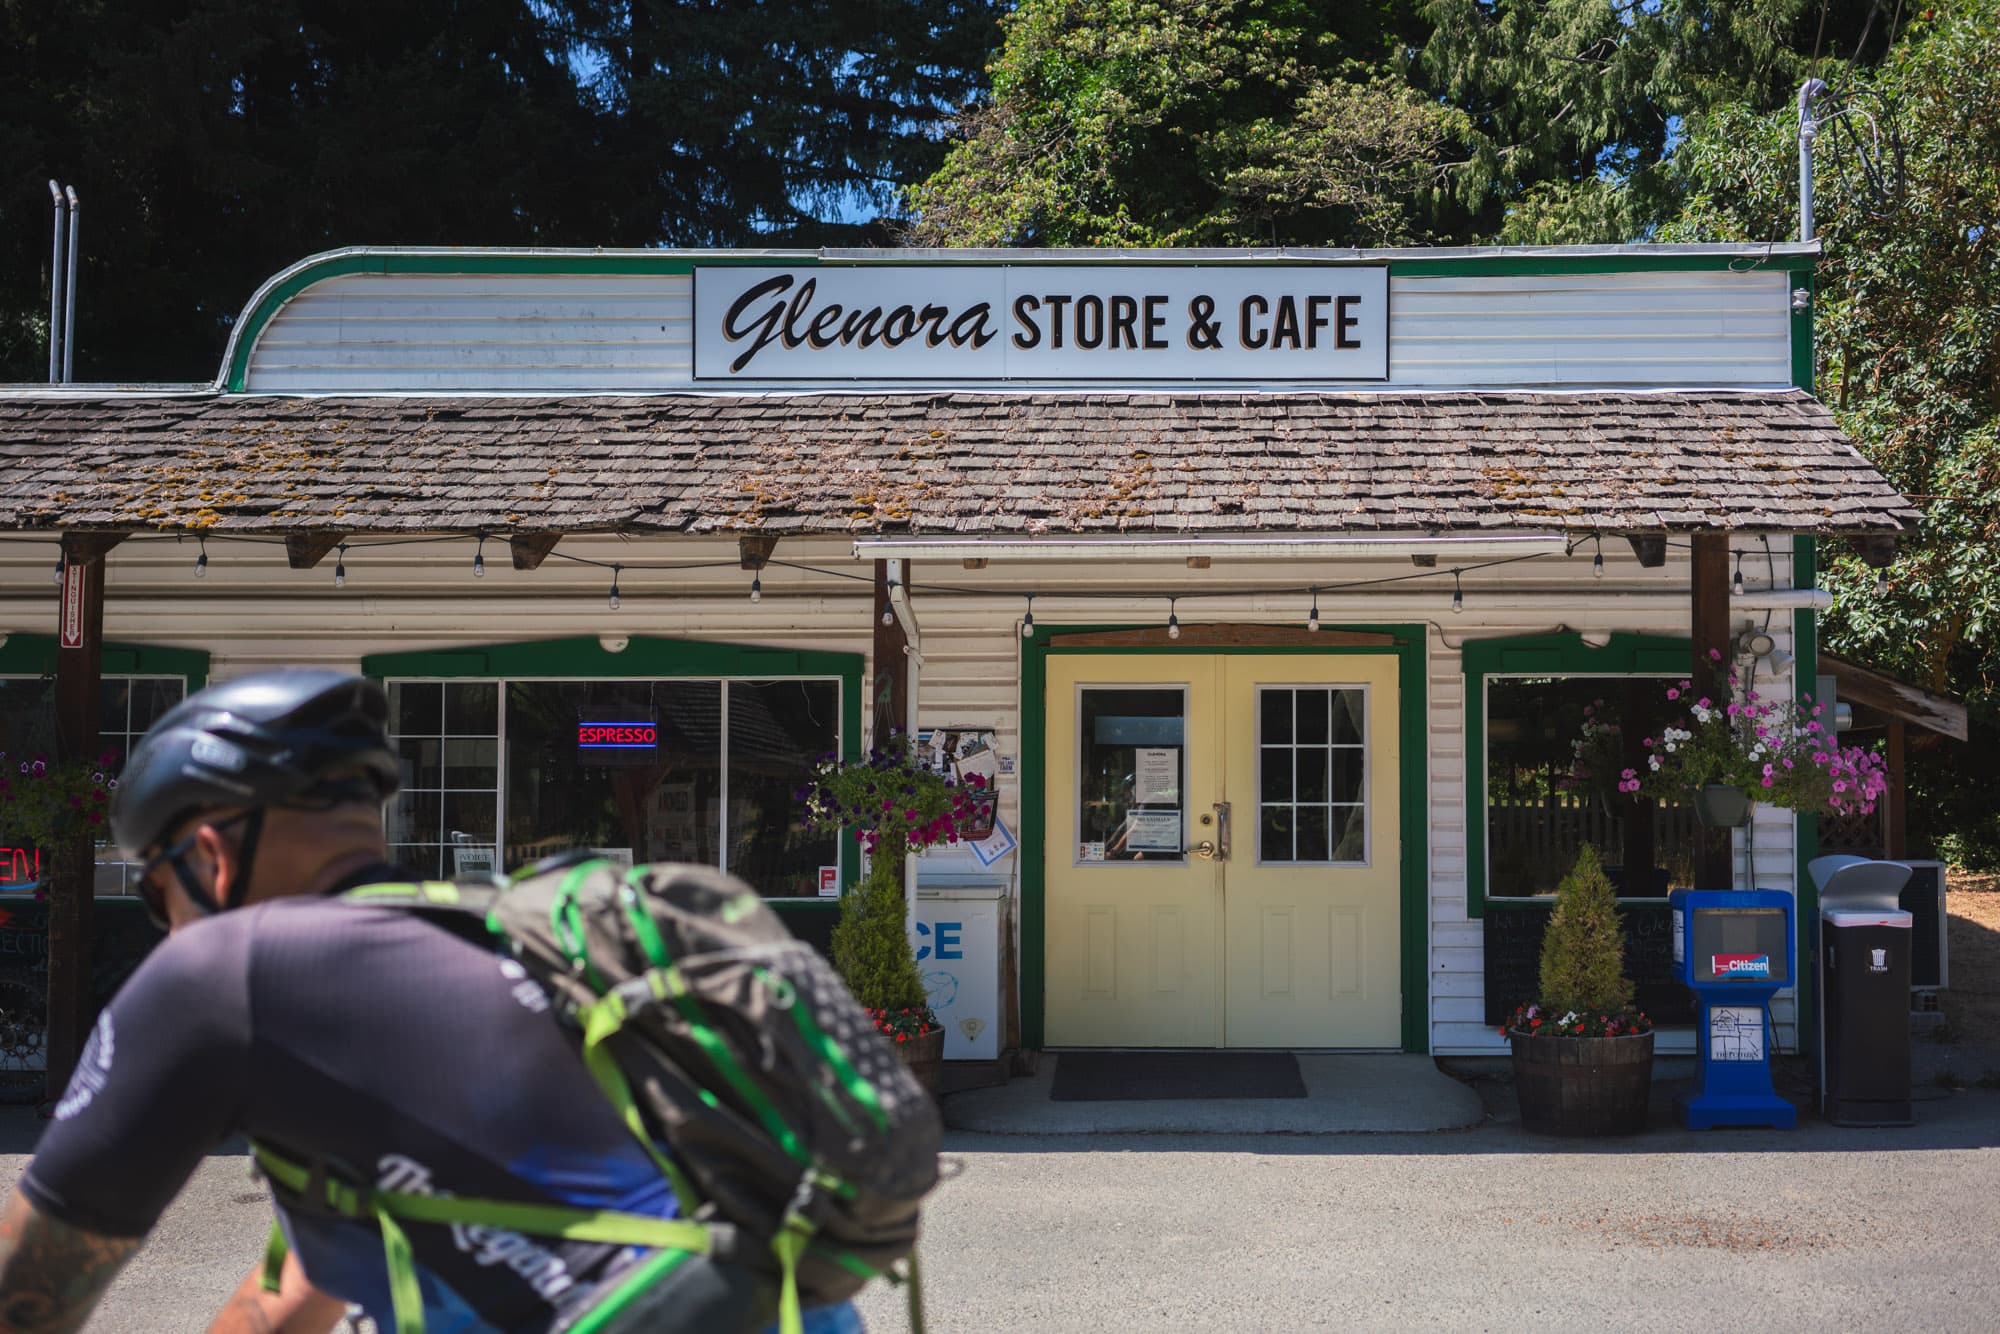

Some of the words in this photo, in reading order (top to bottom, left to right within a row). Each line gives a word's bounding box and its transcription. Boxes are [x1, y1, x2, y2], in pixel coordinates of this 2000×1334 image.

[721, 273, 998, 374] Glenora
[1010, 294, 1169, 350] STORE
[1187, 295, 1224, 350] &
[1238, 294, 1361, 350] CAFE
[69, 567, 79, 637] XTINGUISHER
[579, 727, 656, 743] ESPRESSO
[1729, 960, 1766, 972] Citizen
